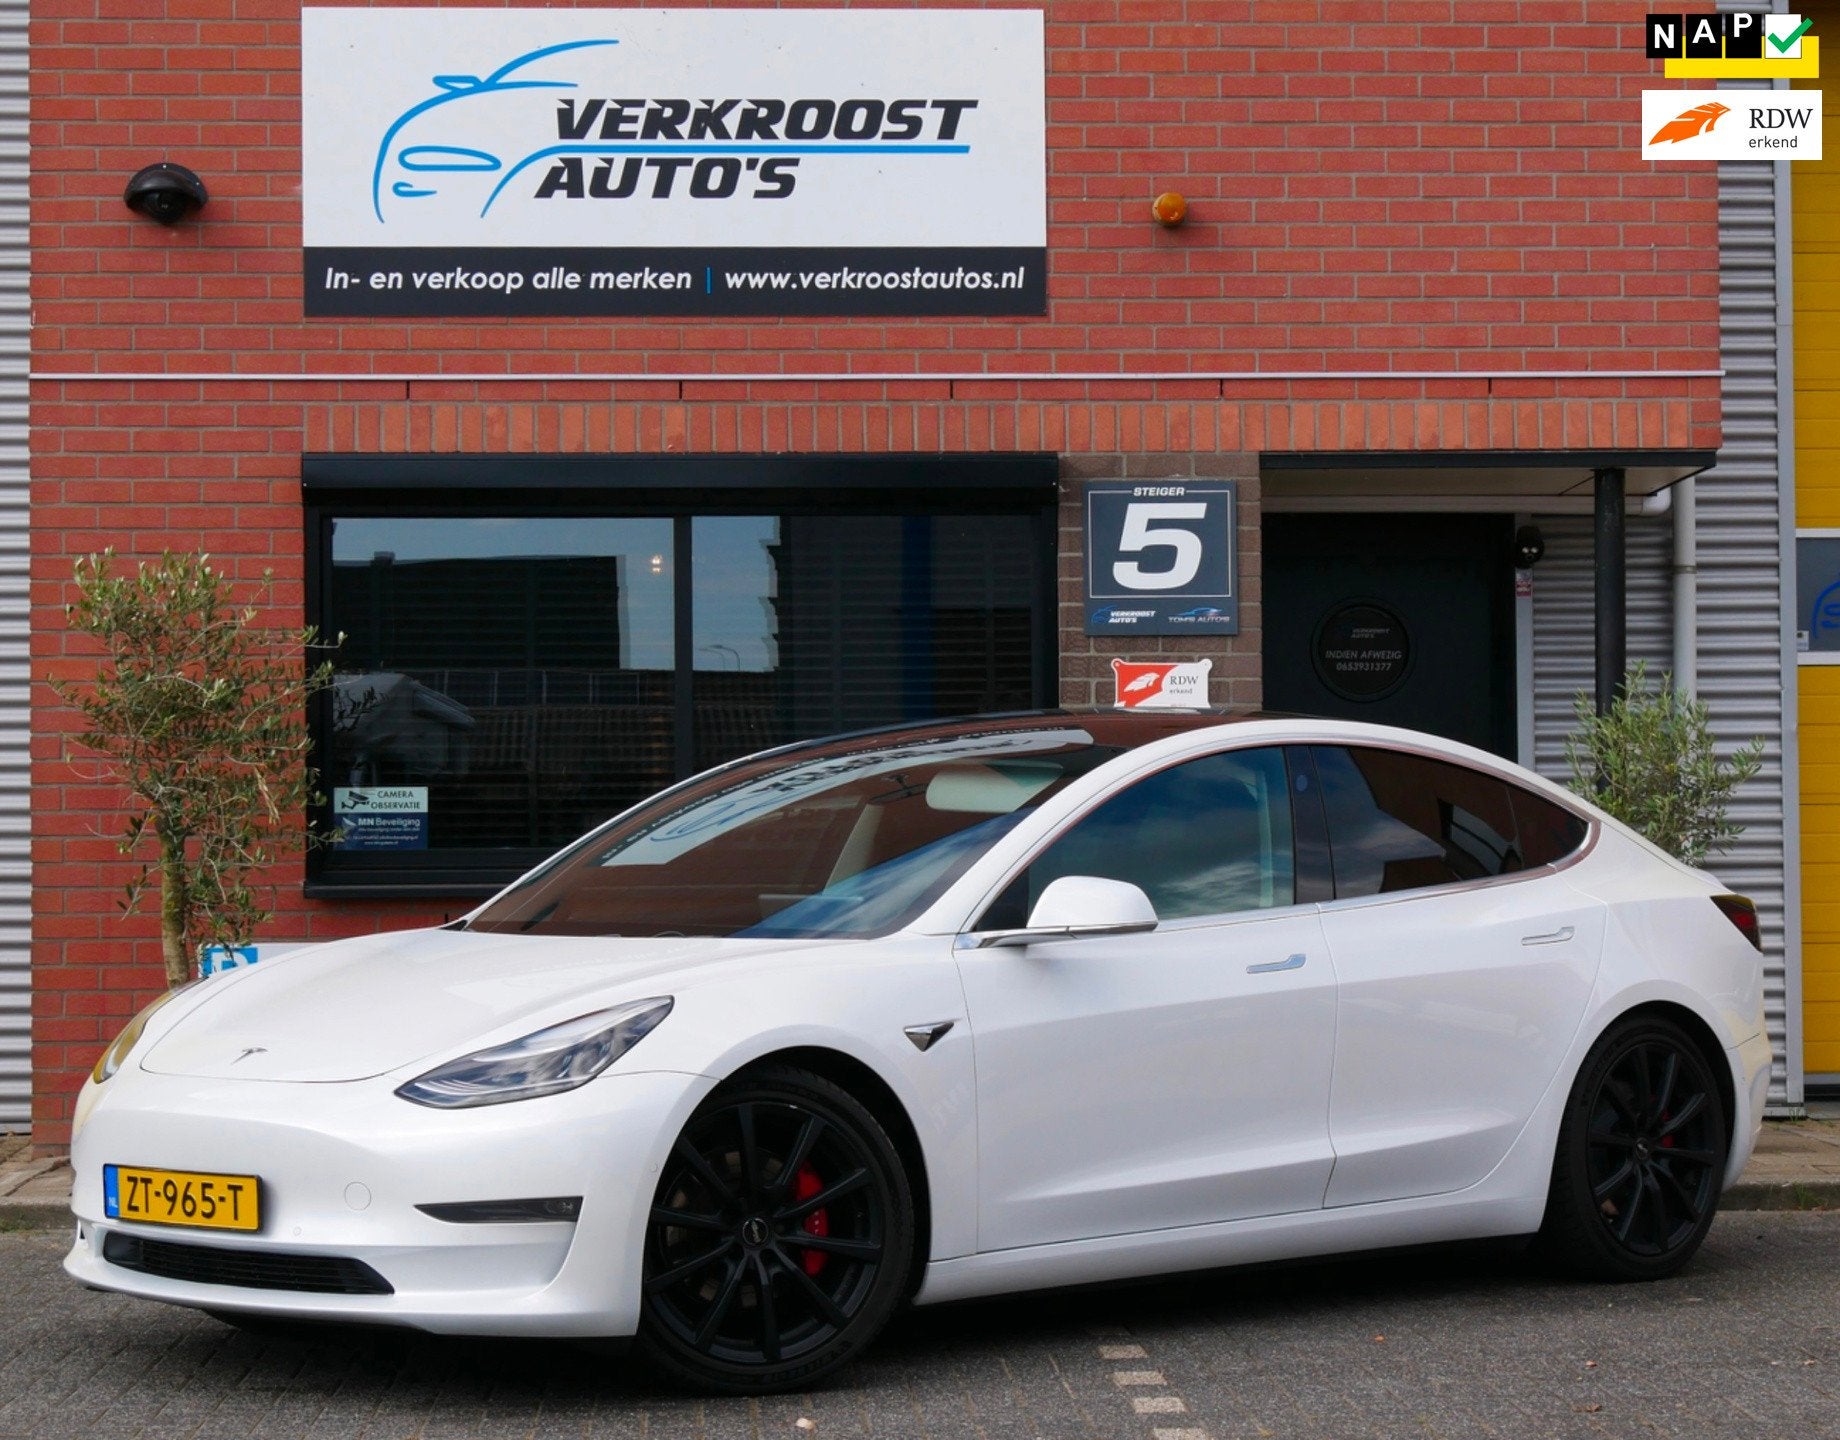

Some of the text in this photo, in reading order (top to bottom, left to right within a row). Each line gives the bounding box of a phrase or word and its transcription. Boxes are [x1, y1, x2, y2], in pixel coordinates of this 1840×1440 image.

[556, 98, 979, 141] VERKROOST
[533, 157, 801, 200] AUTO'S
[325, 267, 1025, 294] In- en verkoop alle merken www.verkroostautos.nl
[1133, 487, 1185, 497] STEIGER
[1112, 502, 1208, 590] 5
[1325, 650, 1359, 659] INDIEN
[1169, 675, 1199, 685] RDW
[376, 790, 414, 799] CAMERA
[370, 801, 421, 810] OBSERVATIE
[358, 817, 375, 826] MN
[126, 1175, 244, 1222] ZT-965-T
